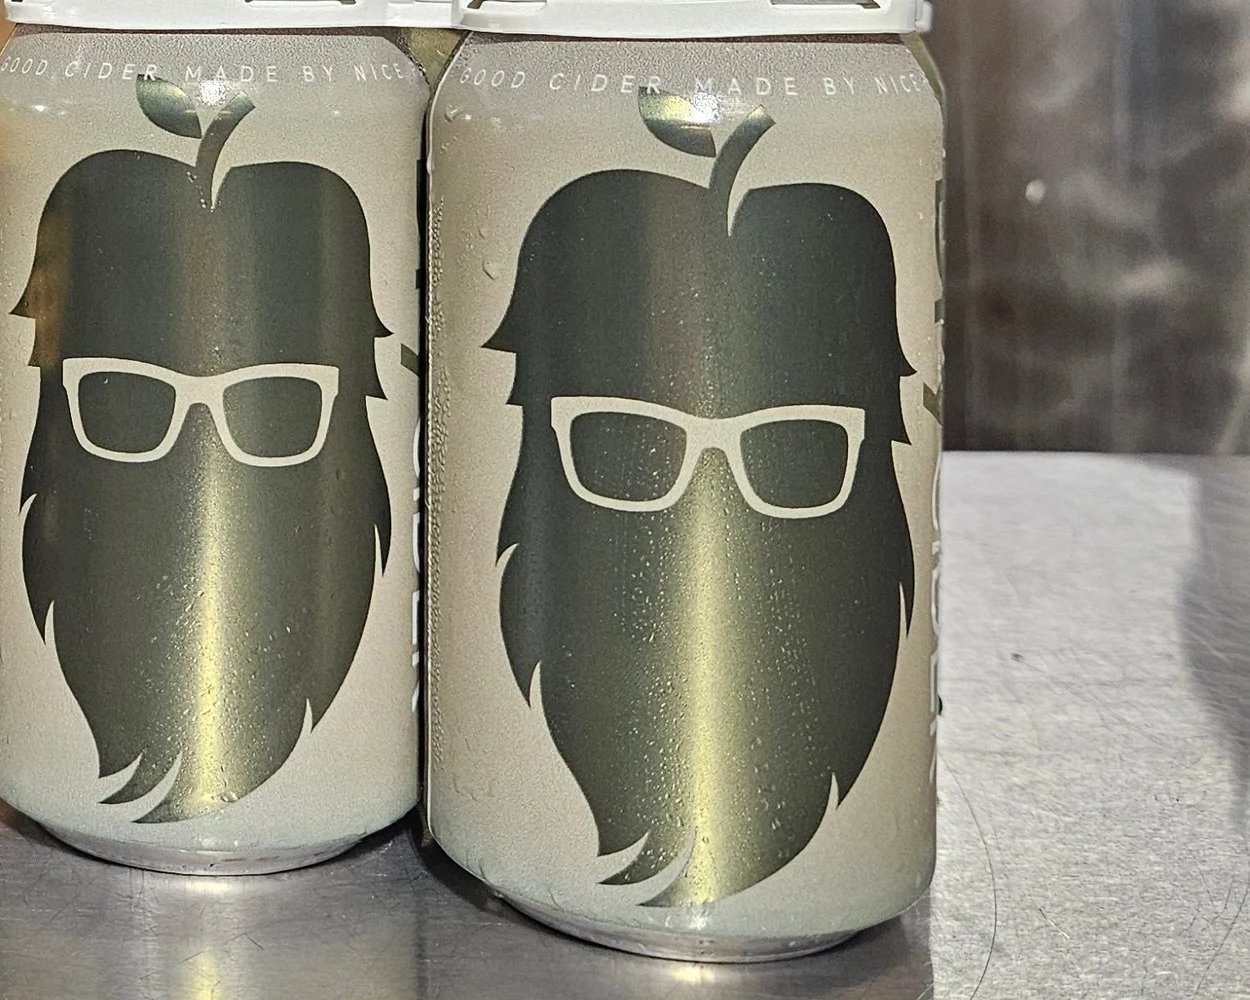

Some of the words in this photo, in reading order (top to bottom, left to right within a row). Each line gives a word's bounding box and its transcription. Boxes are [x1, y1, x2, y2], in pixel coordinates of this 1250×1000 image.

[1, 56, 47, 76] GOOD
[65, 61, 157, 81] CIDER
[185, 65, 279, 83] MADE
[302, 65, 335, 82] BY
[355, 63, 404, 83] NICE
[460, 67, 526, 89] GOOD
[549, 72, 662, 94] CIDER
[694, 77, 798, 96] MADE
[823, 77, 855, 96] BY
[874, 73, 921, 95] NICE
